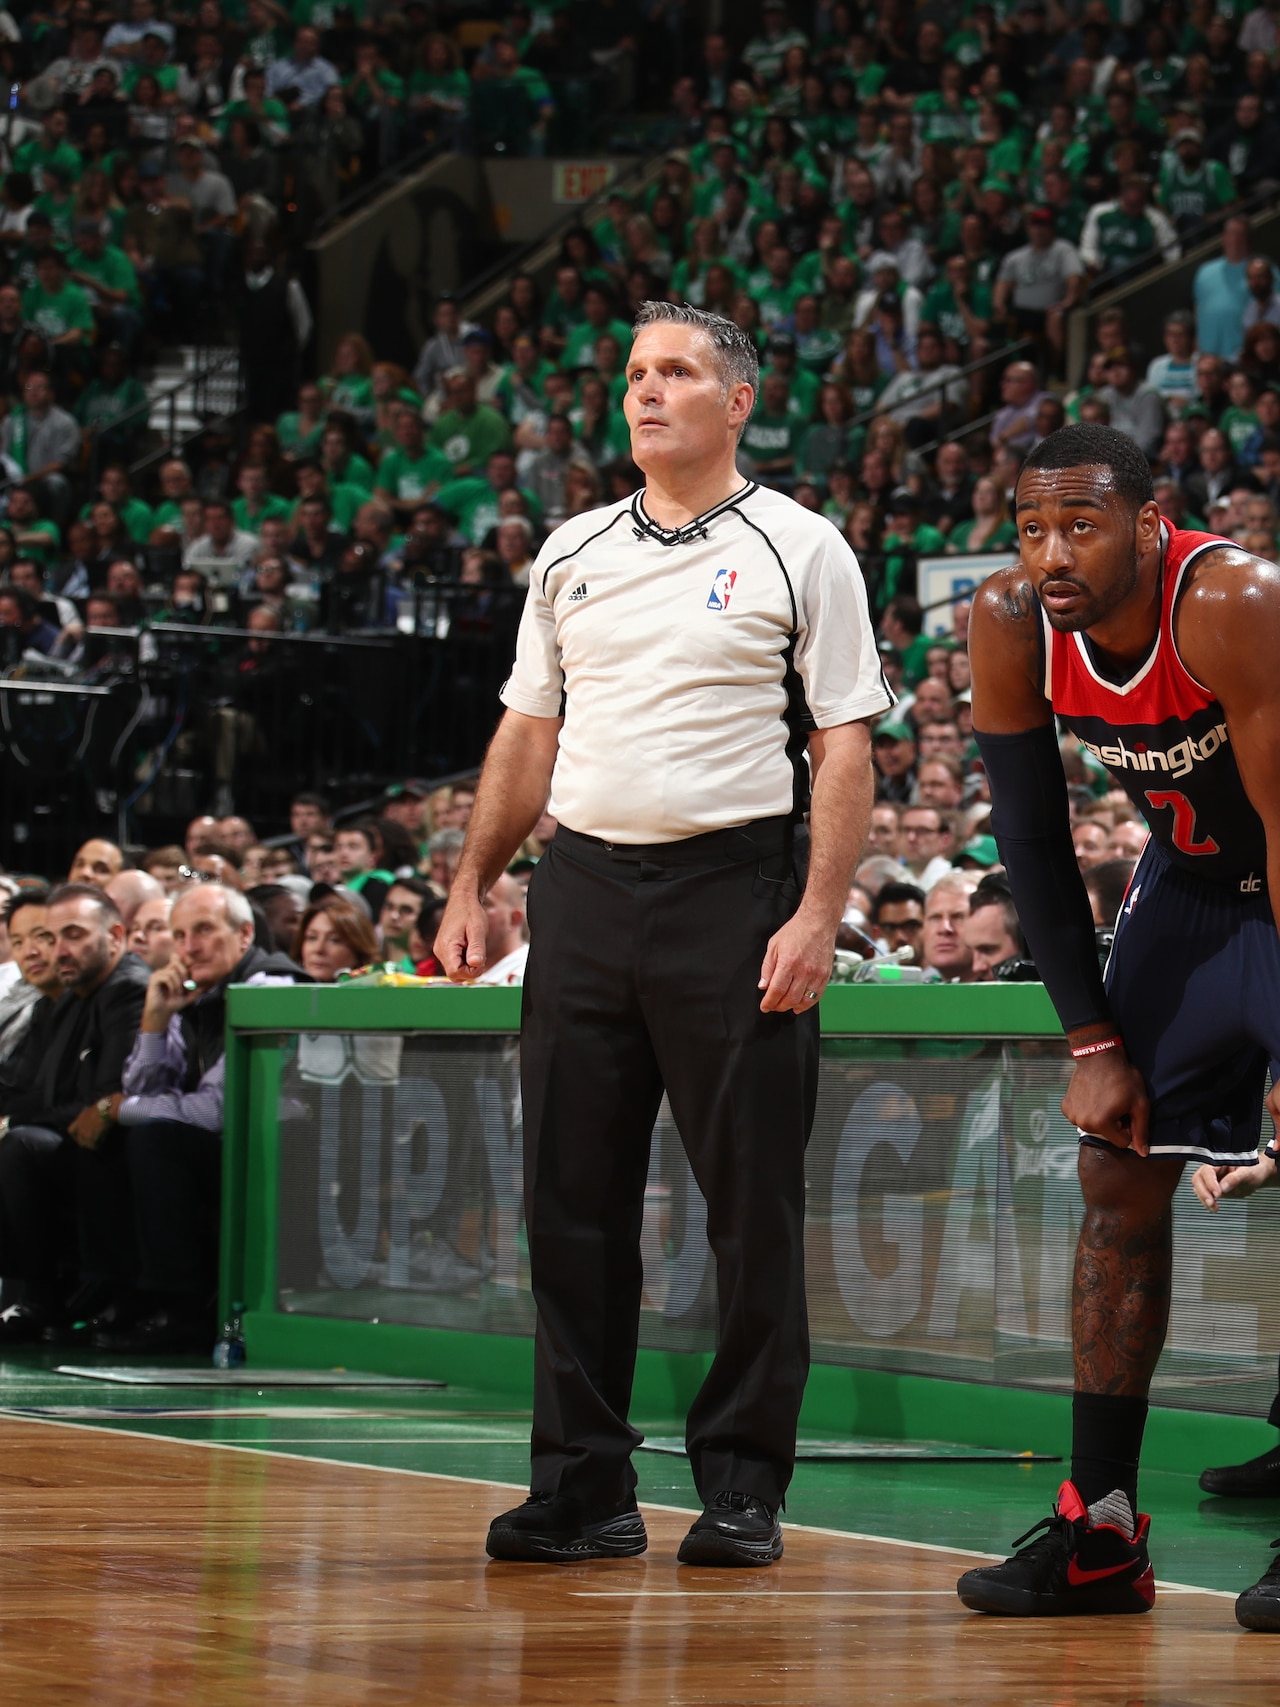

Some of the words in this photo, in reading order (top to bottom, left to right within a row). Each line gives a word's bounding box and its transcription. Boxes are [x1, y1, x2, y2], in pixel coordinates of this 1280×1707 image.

[1144, 789, 1220, 856] 2
[1096, 1041, 1115, 1051] TRULY
[318, 1075, 449, 1289] UP
